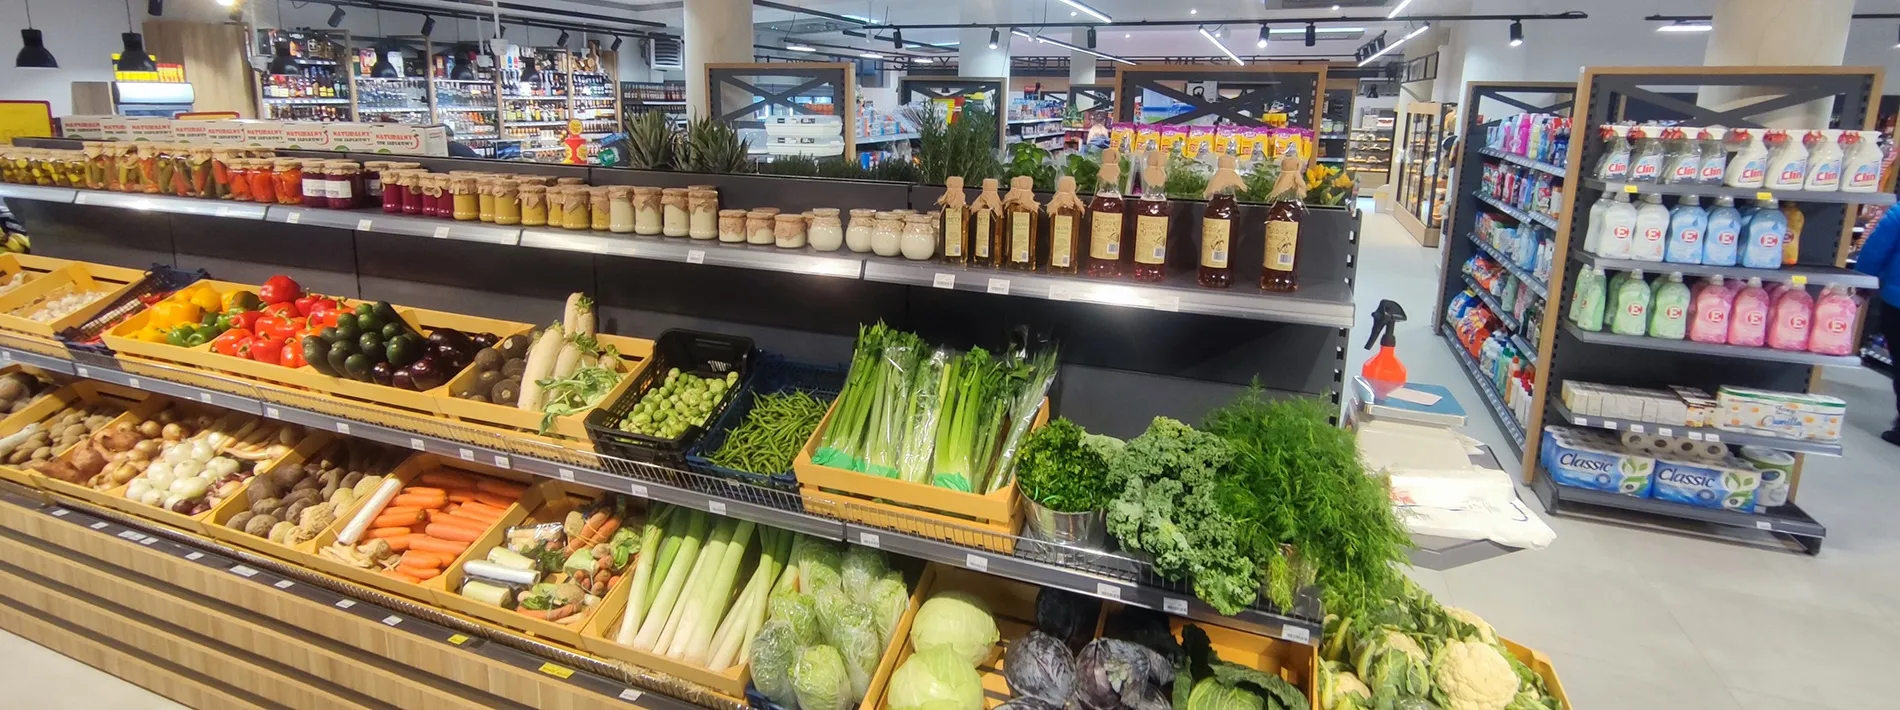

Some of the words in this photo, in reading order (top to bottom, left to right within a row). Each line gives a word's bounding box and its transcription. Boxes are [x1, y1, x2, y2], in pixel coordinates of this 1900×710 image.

[1608, 163, 1627, 173] Clin
[1635, 163, 1656, 174] Clin
[1676, 166, 1697, 177] Clin
[1702, 167, 1722, 177] Clin
[1742, 169, 1763, 179] Clin
[1781, 170, 1802, 181] Clin
[1816, 171, 1838, 182] Clin
[1854, 172, 1876, 183] Clin
[1560, 452, 1613, 473] Classic
[1659, 467, 1716, 488] Classic
